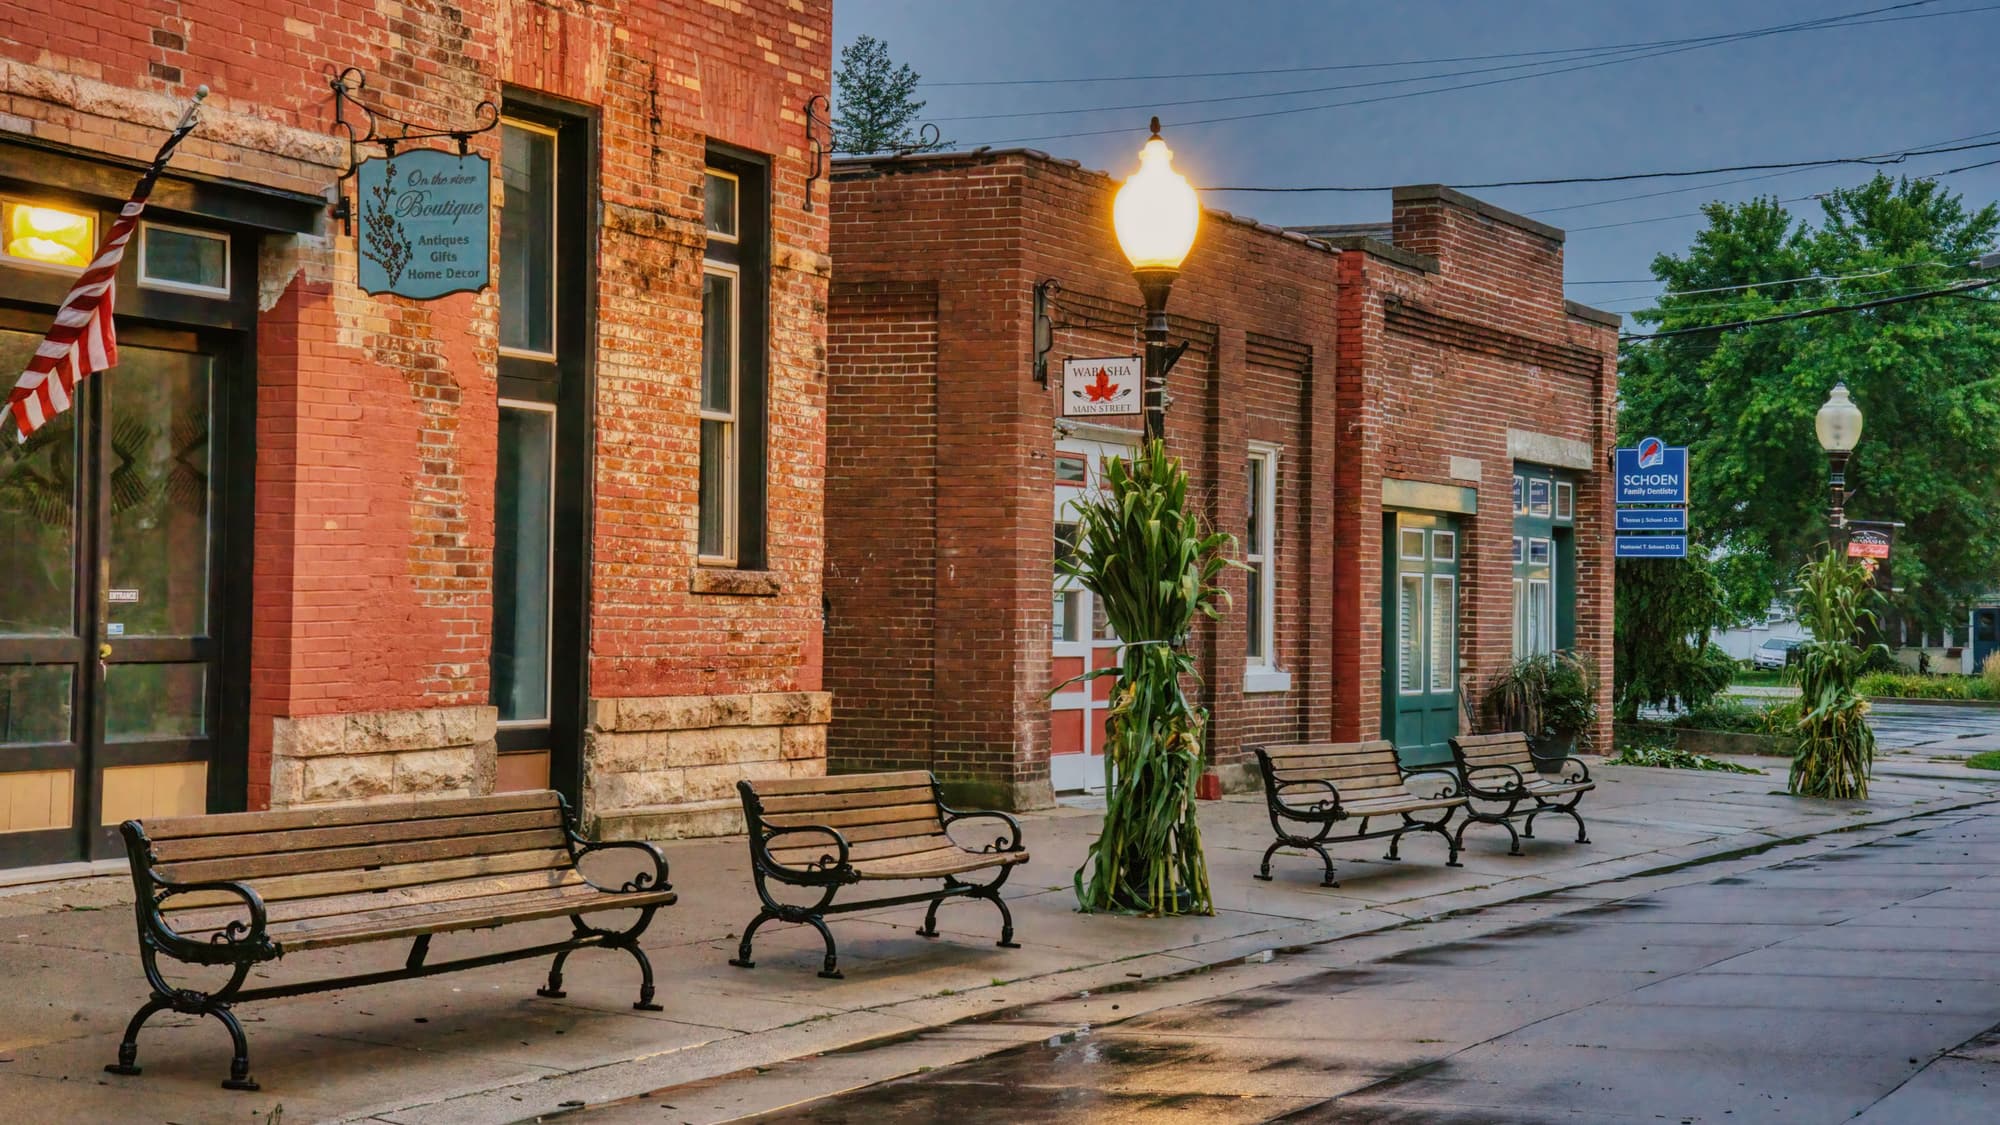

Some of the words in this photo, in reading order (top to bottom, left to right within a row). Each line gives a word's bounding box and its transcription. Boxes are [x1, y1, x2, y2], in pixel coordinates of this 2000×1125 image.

[408, 169, 429, 187] On
[431, 171, 448, 185] the
[450, 174, 476, 185] river
[395, 190, 483, 225] Boutique
[418, 235, 470, 247] Antiques
[430, 251, 457, 263] Gifts
[408, 269, 442, 280] Home
[446, 268, 480, 279] Decor
[1099, 404, 1132, 412] STREET
[1623, 475, 1678, 485] SCHOEN
[1624, 488, 1646, 496] Family
[1647, 488, 1678, 496] Dentistry
[109, 591, 137, 600] ENTRANCE
